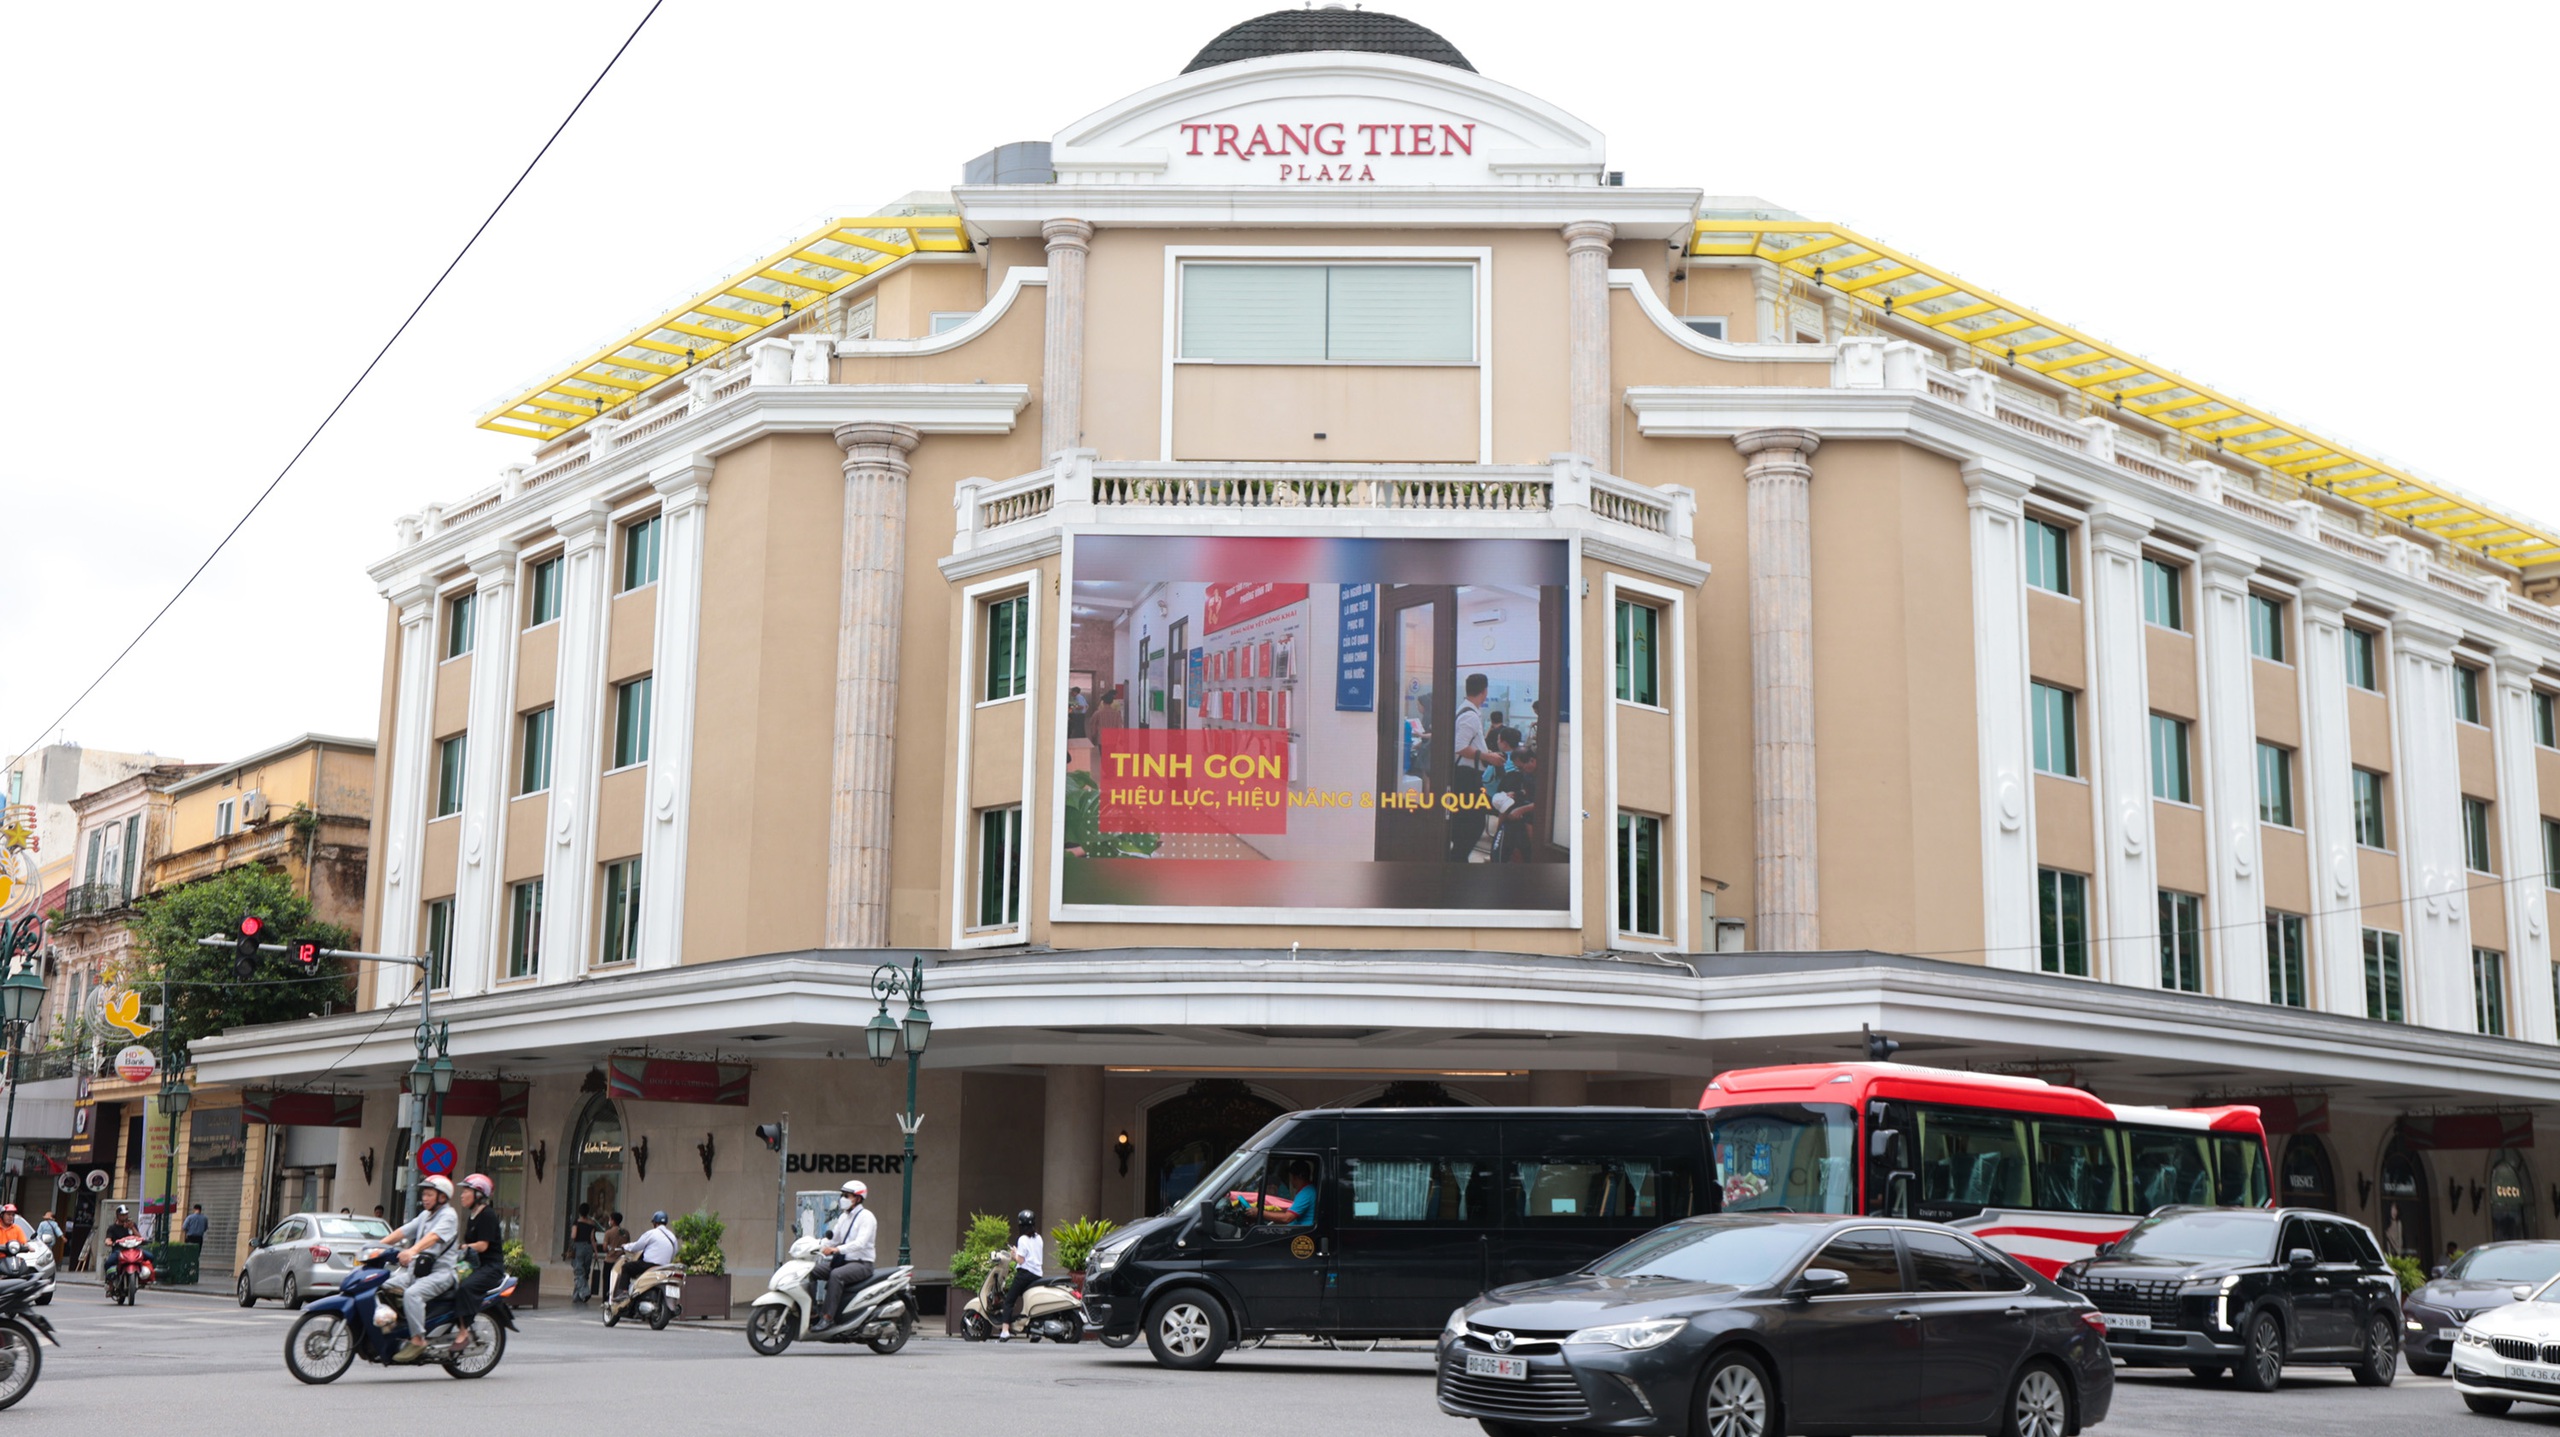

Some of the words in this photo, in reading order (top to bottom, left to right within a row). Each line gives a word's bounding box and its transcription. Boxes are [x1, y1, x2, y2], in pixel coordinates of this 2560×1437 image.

[1180, 123, 1346, 161] TRANG
[1358, 123, 1476, 156] TIEN
[1279, 163, 1375, 181] PLAZA
[1110, 753, 1192, 778] TINH
[1204, 754, 1281, 785] GỌN
[1110, 785, 1163, 810] HIỆU
[1170, 787, 1220, 811] LỰC,
[1227, 787, 1280, 811] HIỆU
[1287, 787, 1353, 808] NĂNG
[1359, 793, 1374, 808] &
[1380, 788, 1434, 813] HIỆU
[1440, 787, 1491, 812] QUẢ
[299, 944, 314, 962] 12
[2496, 1185, 2520, 1198] GUCCI
